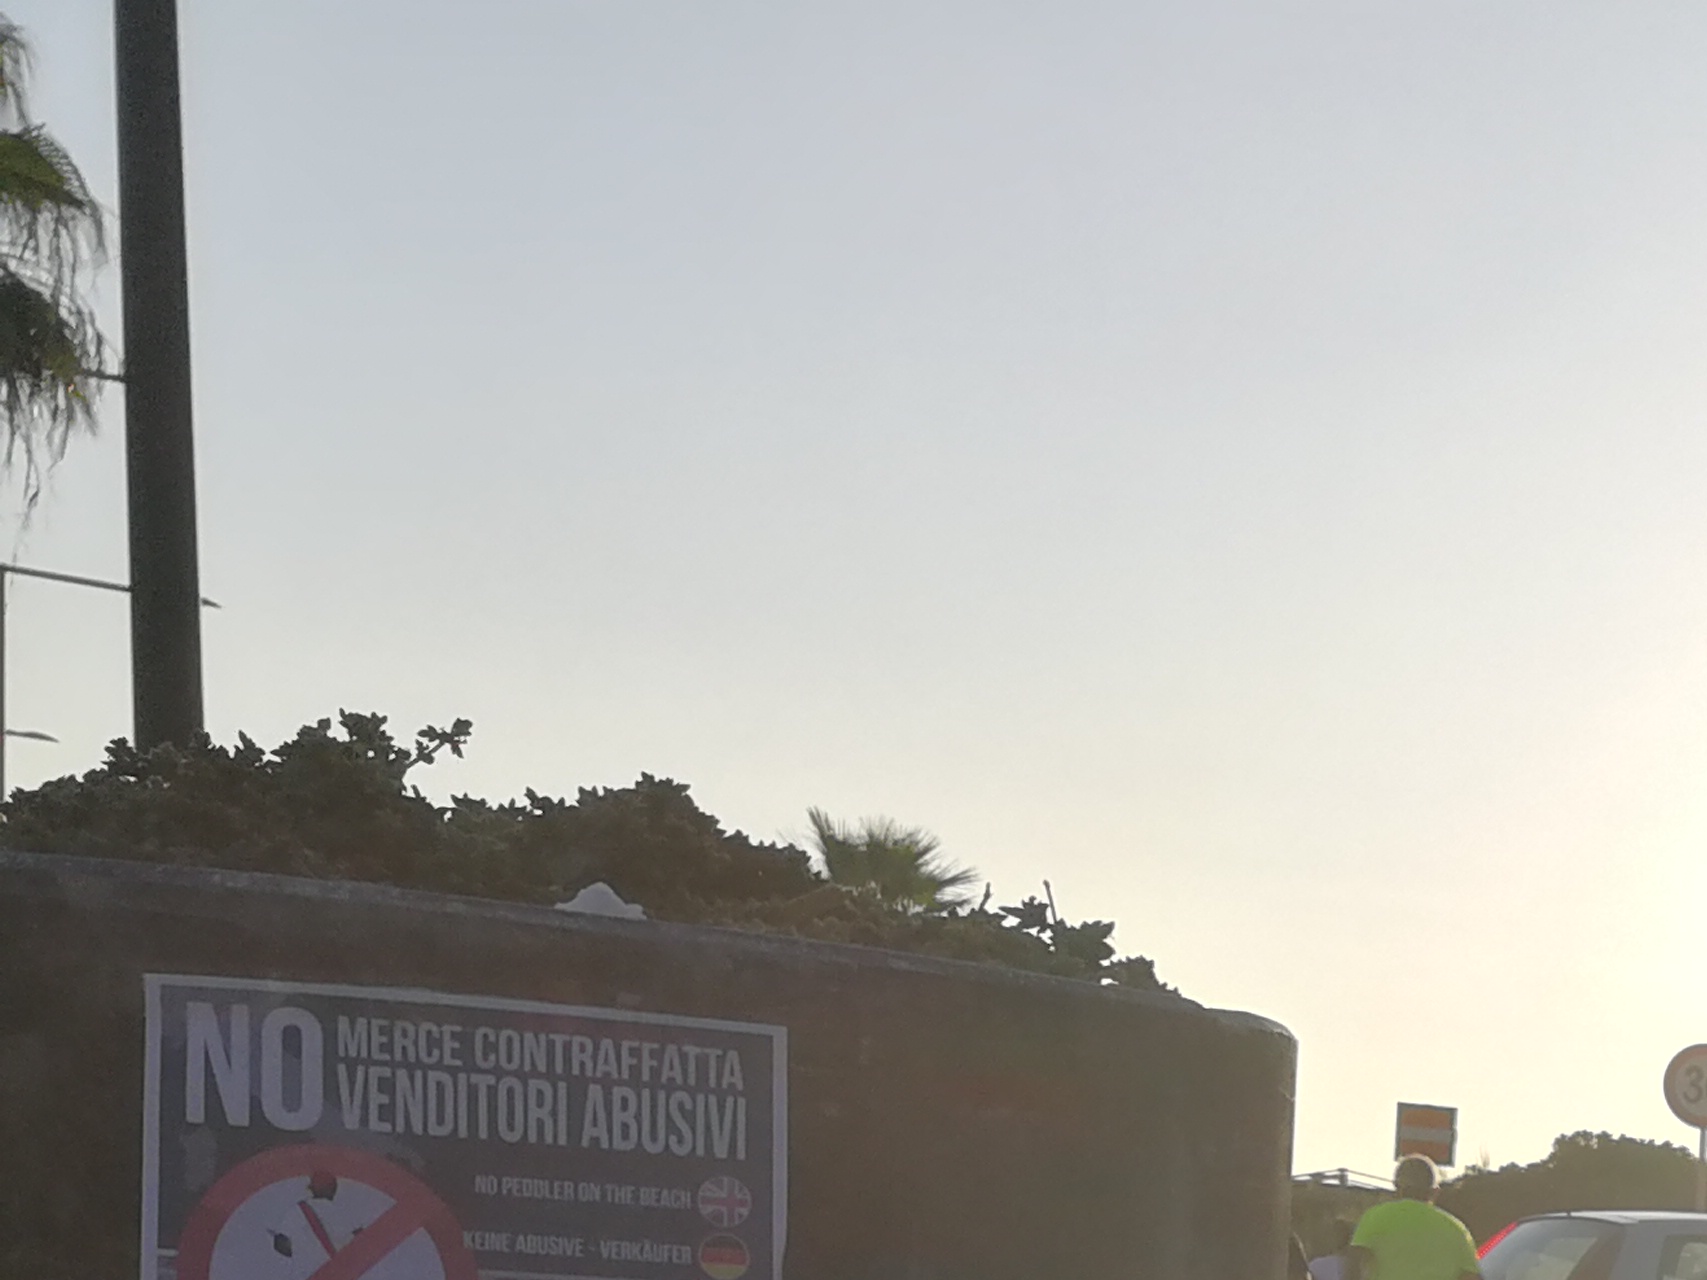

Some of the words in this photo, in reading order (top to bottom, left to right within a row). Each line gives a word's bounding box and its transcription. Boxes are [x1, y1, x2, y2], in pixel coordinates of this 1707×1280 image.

[184, 1000, 325, 1131] NO
[337, 1014, 463, 1067] MERCE
[473, 1029, 744, 1091] CONTRAFFATTA
[336, 1063, 568, 1146] VENDITORI
[580, 1088, 747, 1160] ABUSIVI
[474, 1174, 498, 1195] NO
[501, 1178, 574, 1202] PEDDLER
[578, 1182, 602, 1203] ON
[605, 1183, 635, 1206] THE
[638, 1186, 692, 1210] BEACH
[462, 1229, 511, 1252] KEINE
[514, 1234, 584, 1258] ABUSIVE
[598, 1238, 692, 1265] VERKÄUFER
